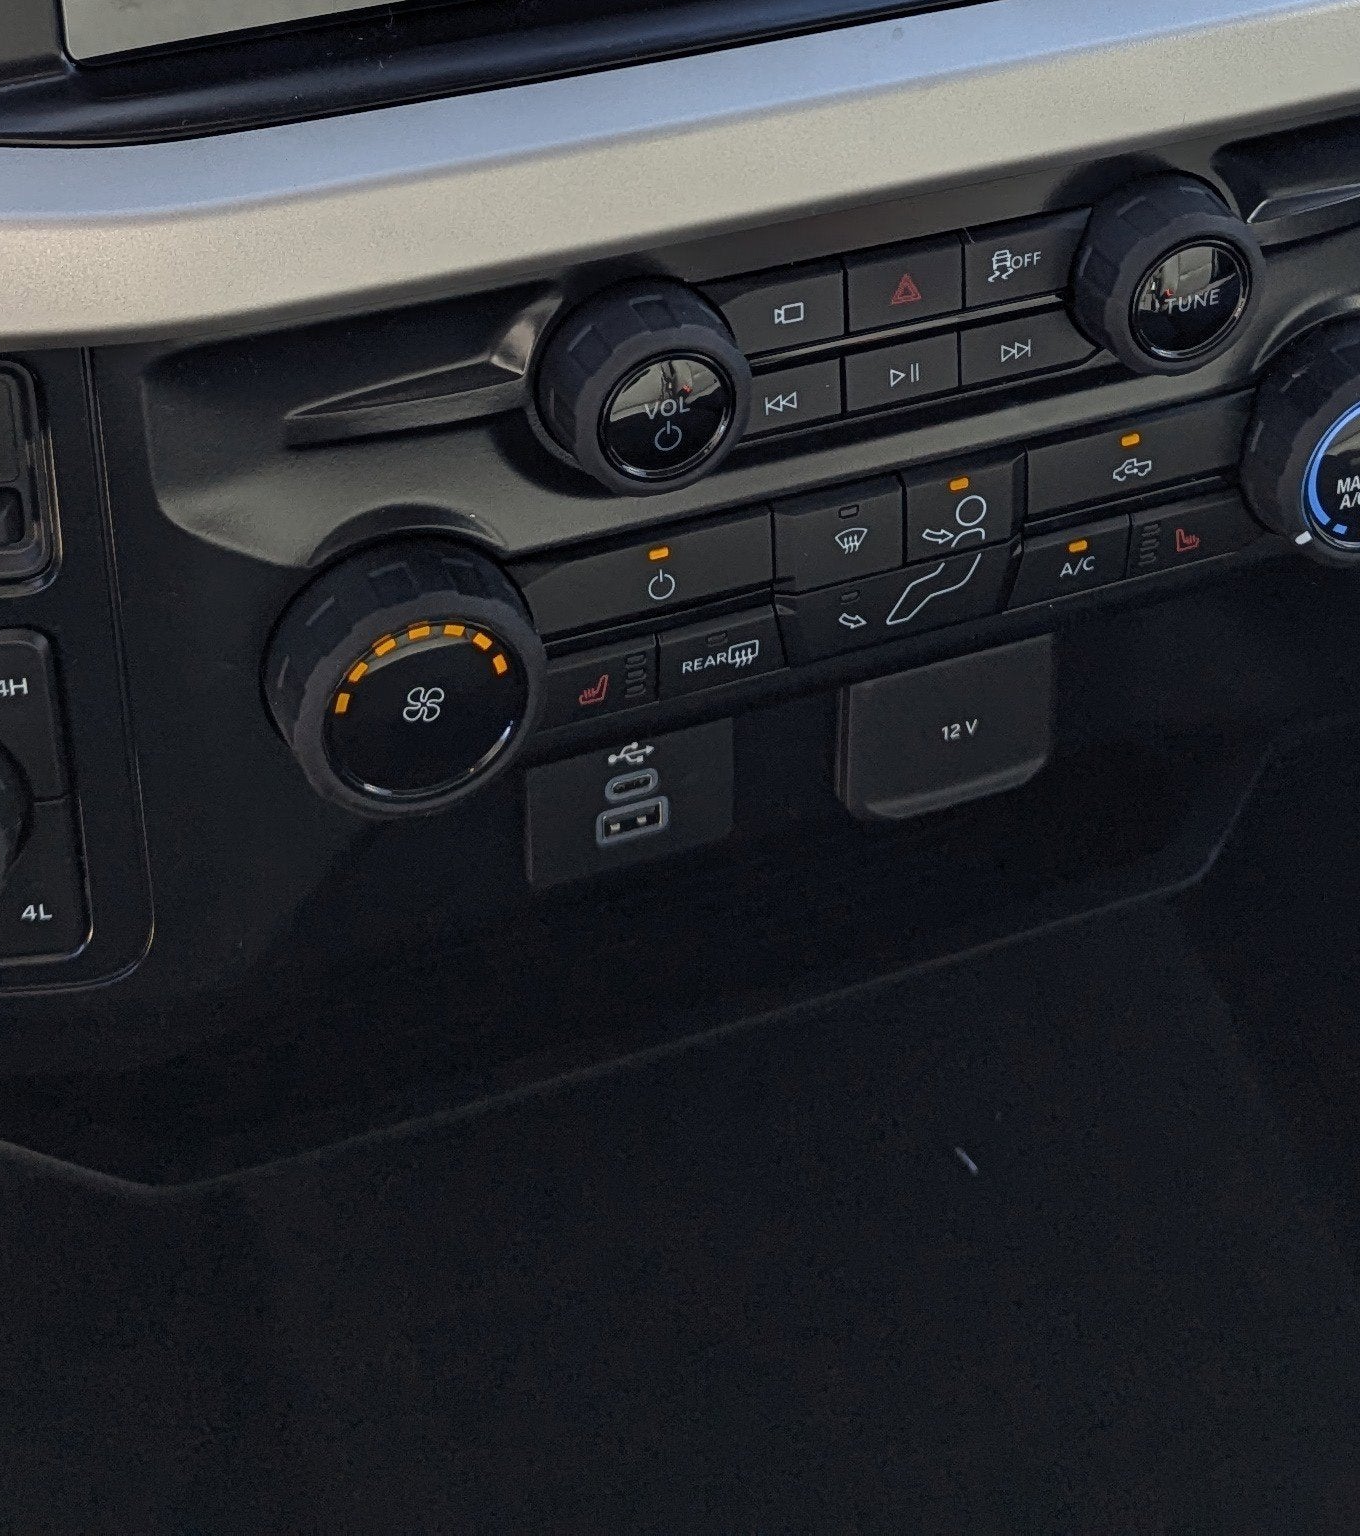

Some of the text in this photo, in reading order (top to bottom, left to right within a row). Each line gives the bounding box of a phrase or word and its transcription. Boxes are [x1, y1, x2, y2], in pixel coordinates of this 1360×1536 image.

[1011, 250, 1042, 269] OFF
[1163, 289, 1222, 315] TUNE
[644, 397, 691, 421] VOL
[1059, 555, 1096, 578] A/C
[681, 650, 728, 674] REAR
[941, 717, 979, 741] 12 V
[20, 904, 53, 922] 4L
